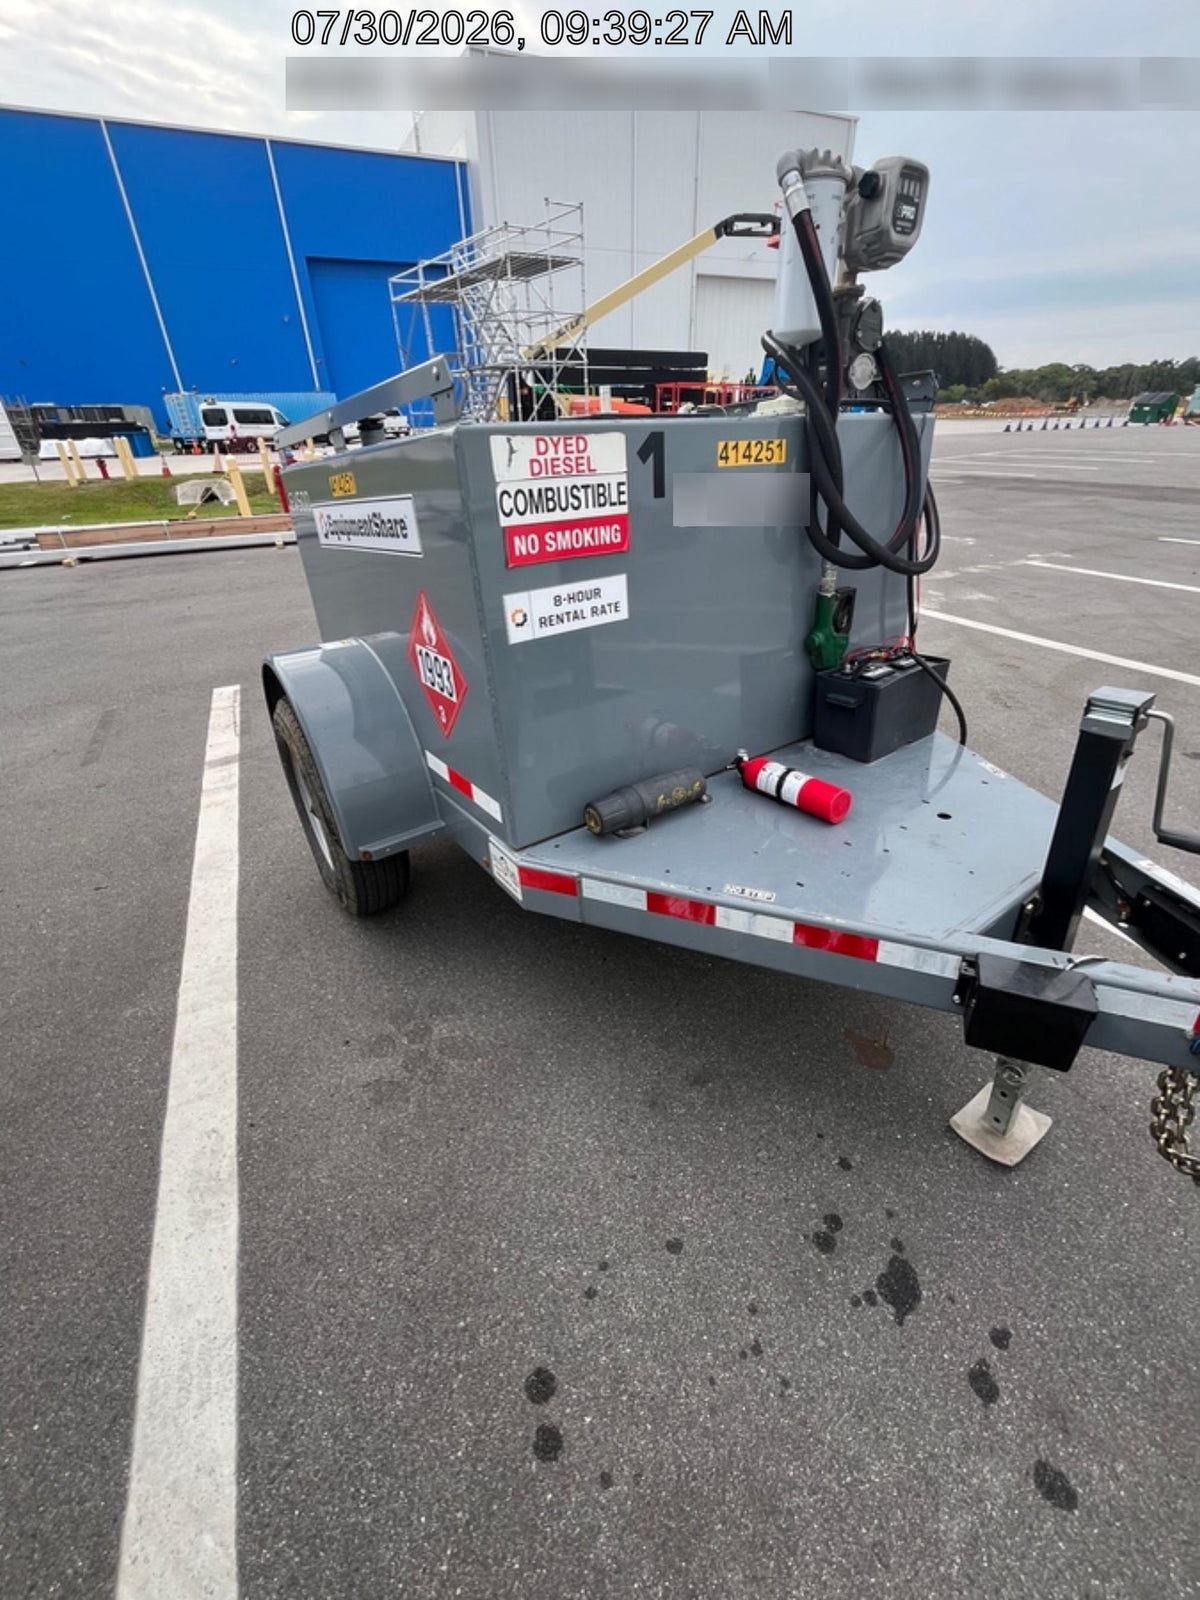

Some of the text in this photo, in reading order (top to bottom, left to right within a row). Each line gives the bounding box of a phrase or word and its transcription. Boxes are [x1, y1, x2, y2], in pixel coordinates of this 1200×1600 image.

[535, 435, 588, 456] DYED
[719, 439, 784, 464] 414251
[528, 455, 597, 477] DIESEL
[637, 431, 665, 498] 1
[499, 481, 627, 518] COMBUSTIBLE
[513, 524, 621, 556] NO SMOKING
[553, 587, 602, 607] 8-HOUR
[538, 600, 621, 628] RENTAL RATE
[418, 648, 454, 698] 1993
